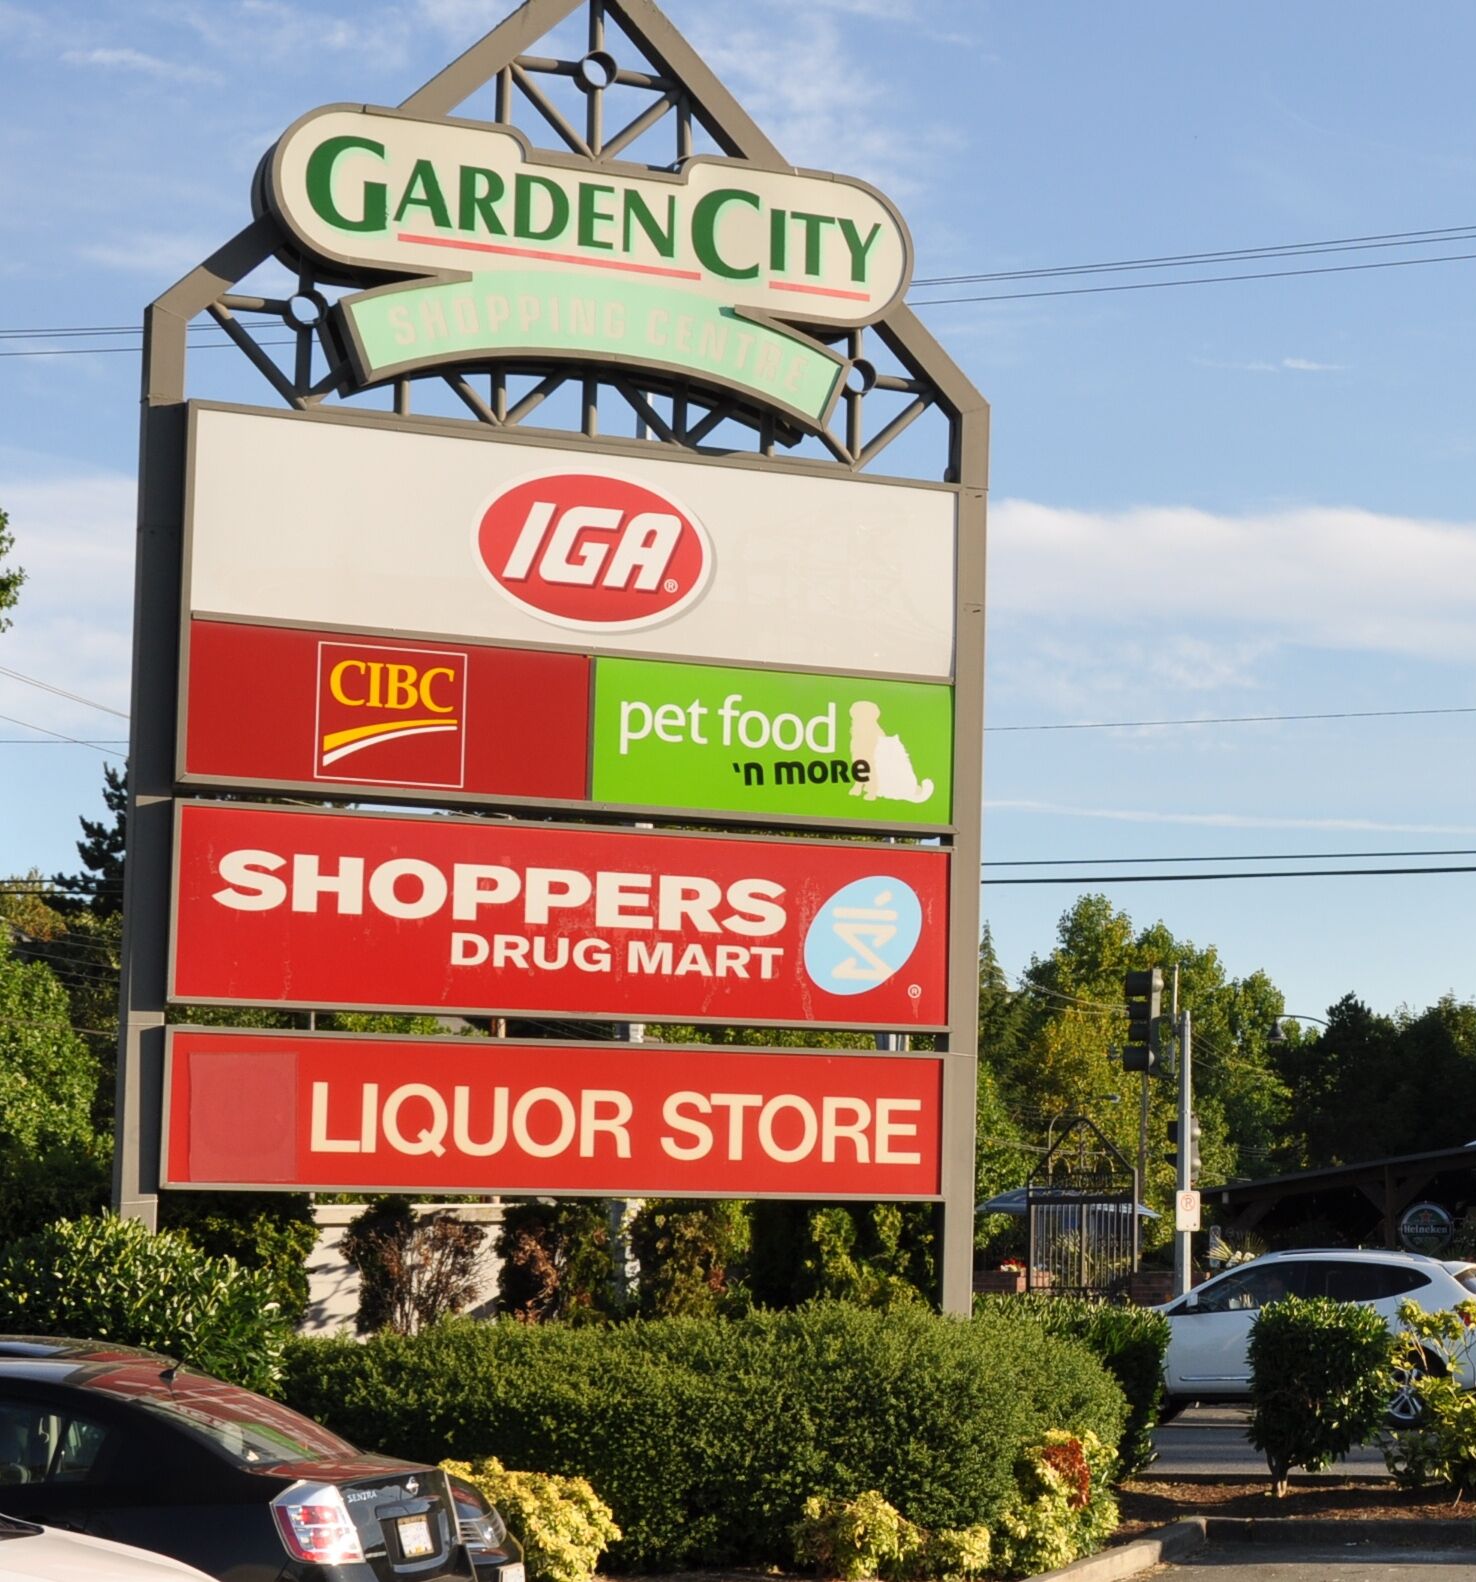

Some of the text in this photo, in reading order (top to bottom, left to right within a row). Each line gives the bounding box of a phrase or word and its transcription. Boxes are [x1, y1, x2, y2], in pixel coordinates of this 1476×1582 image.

[388, 293, 808, 392] SHOPPING CENTRE
[330, 660, 455, 712] CIBC
[619, 694, 836, 754] pet food
[212, 849, 787, 937] SHOPPERS
[450, 932, 784, 979] DRUG MART
[310, 1081, 922, 1165] LIQUOR STORE
[347, 1490, 377, 1503] SENTRA
